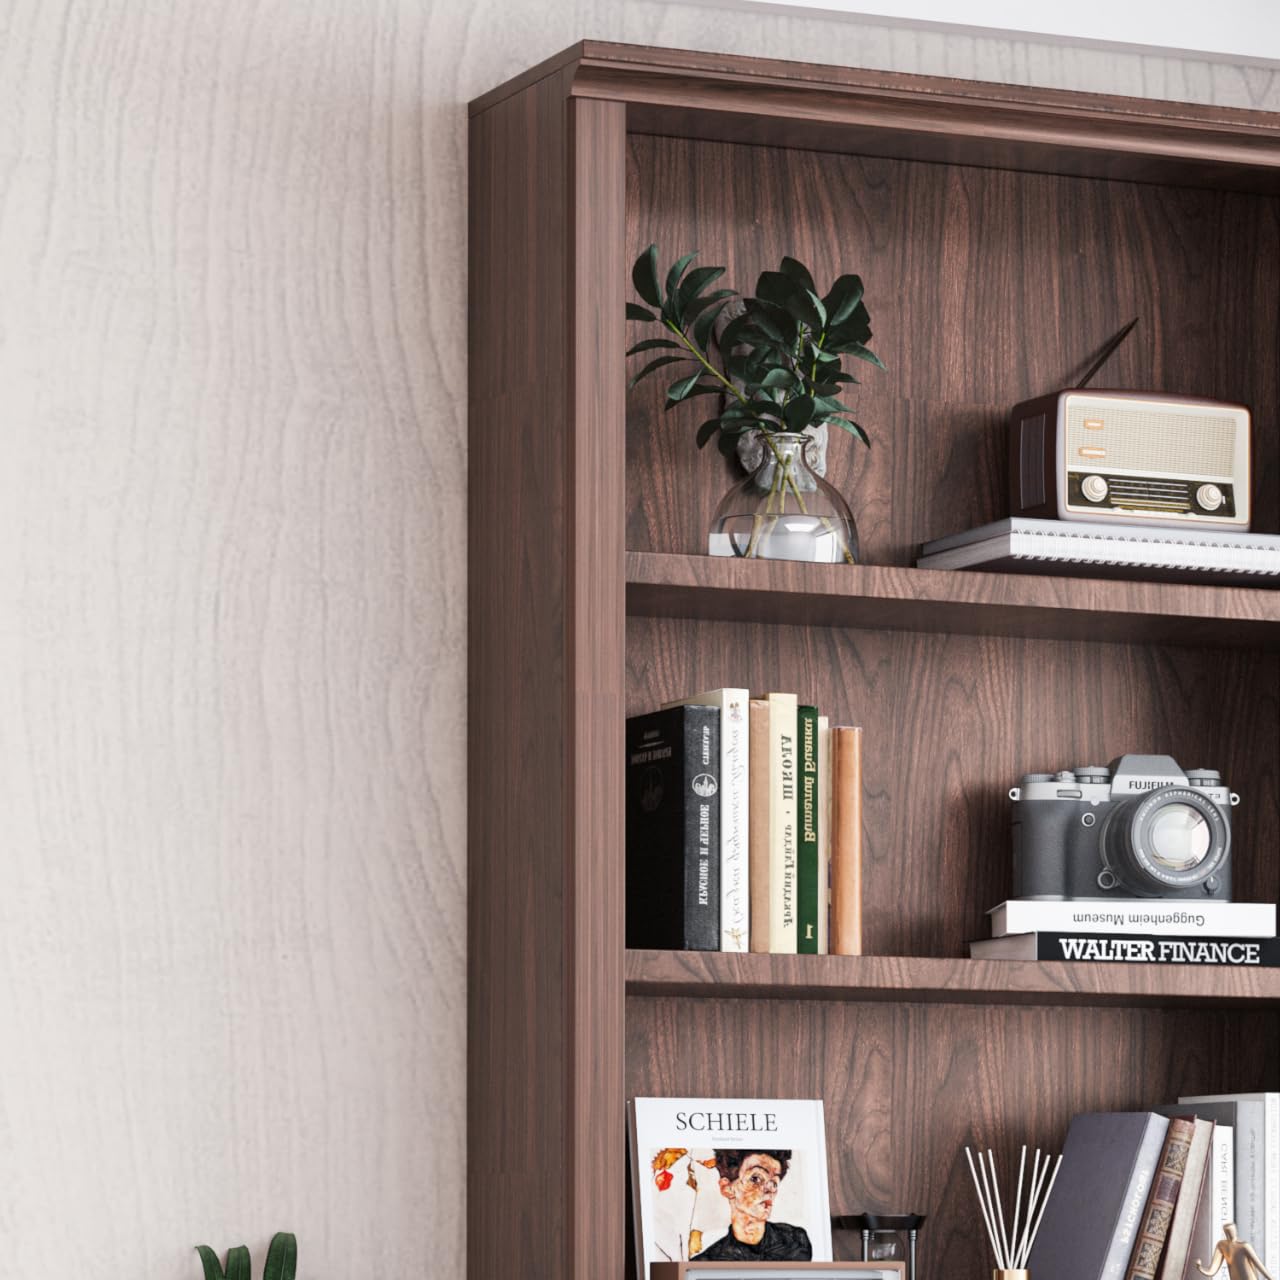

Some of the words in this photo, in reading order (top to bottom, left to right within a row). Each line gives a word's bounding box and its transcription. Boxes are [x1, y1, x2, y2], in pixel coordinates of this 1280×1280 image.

[1072, 912, 1124, 926] Museum
[1128, 912, 1206, 927] Guggenheim
[1058, 938, 1156, 962] WALTER
[1158, 942, 1260, 964] FINANCE
[676, 1112, 778, 1132] SCHIELE
